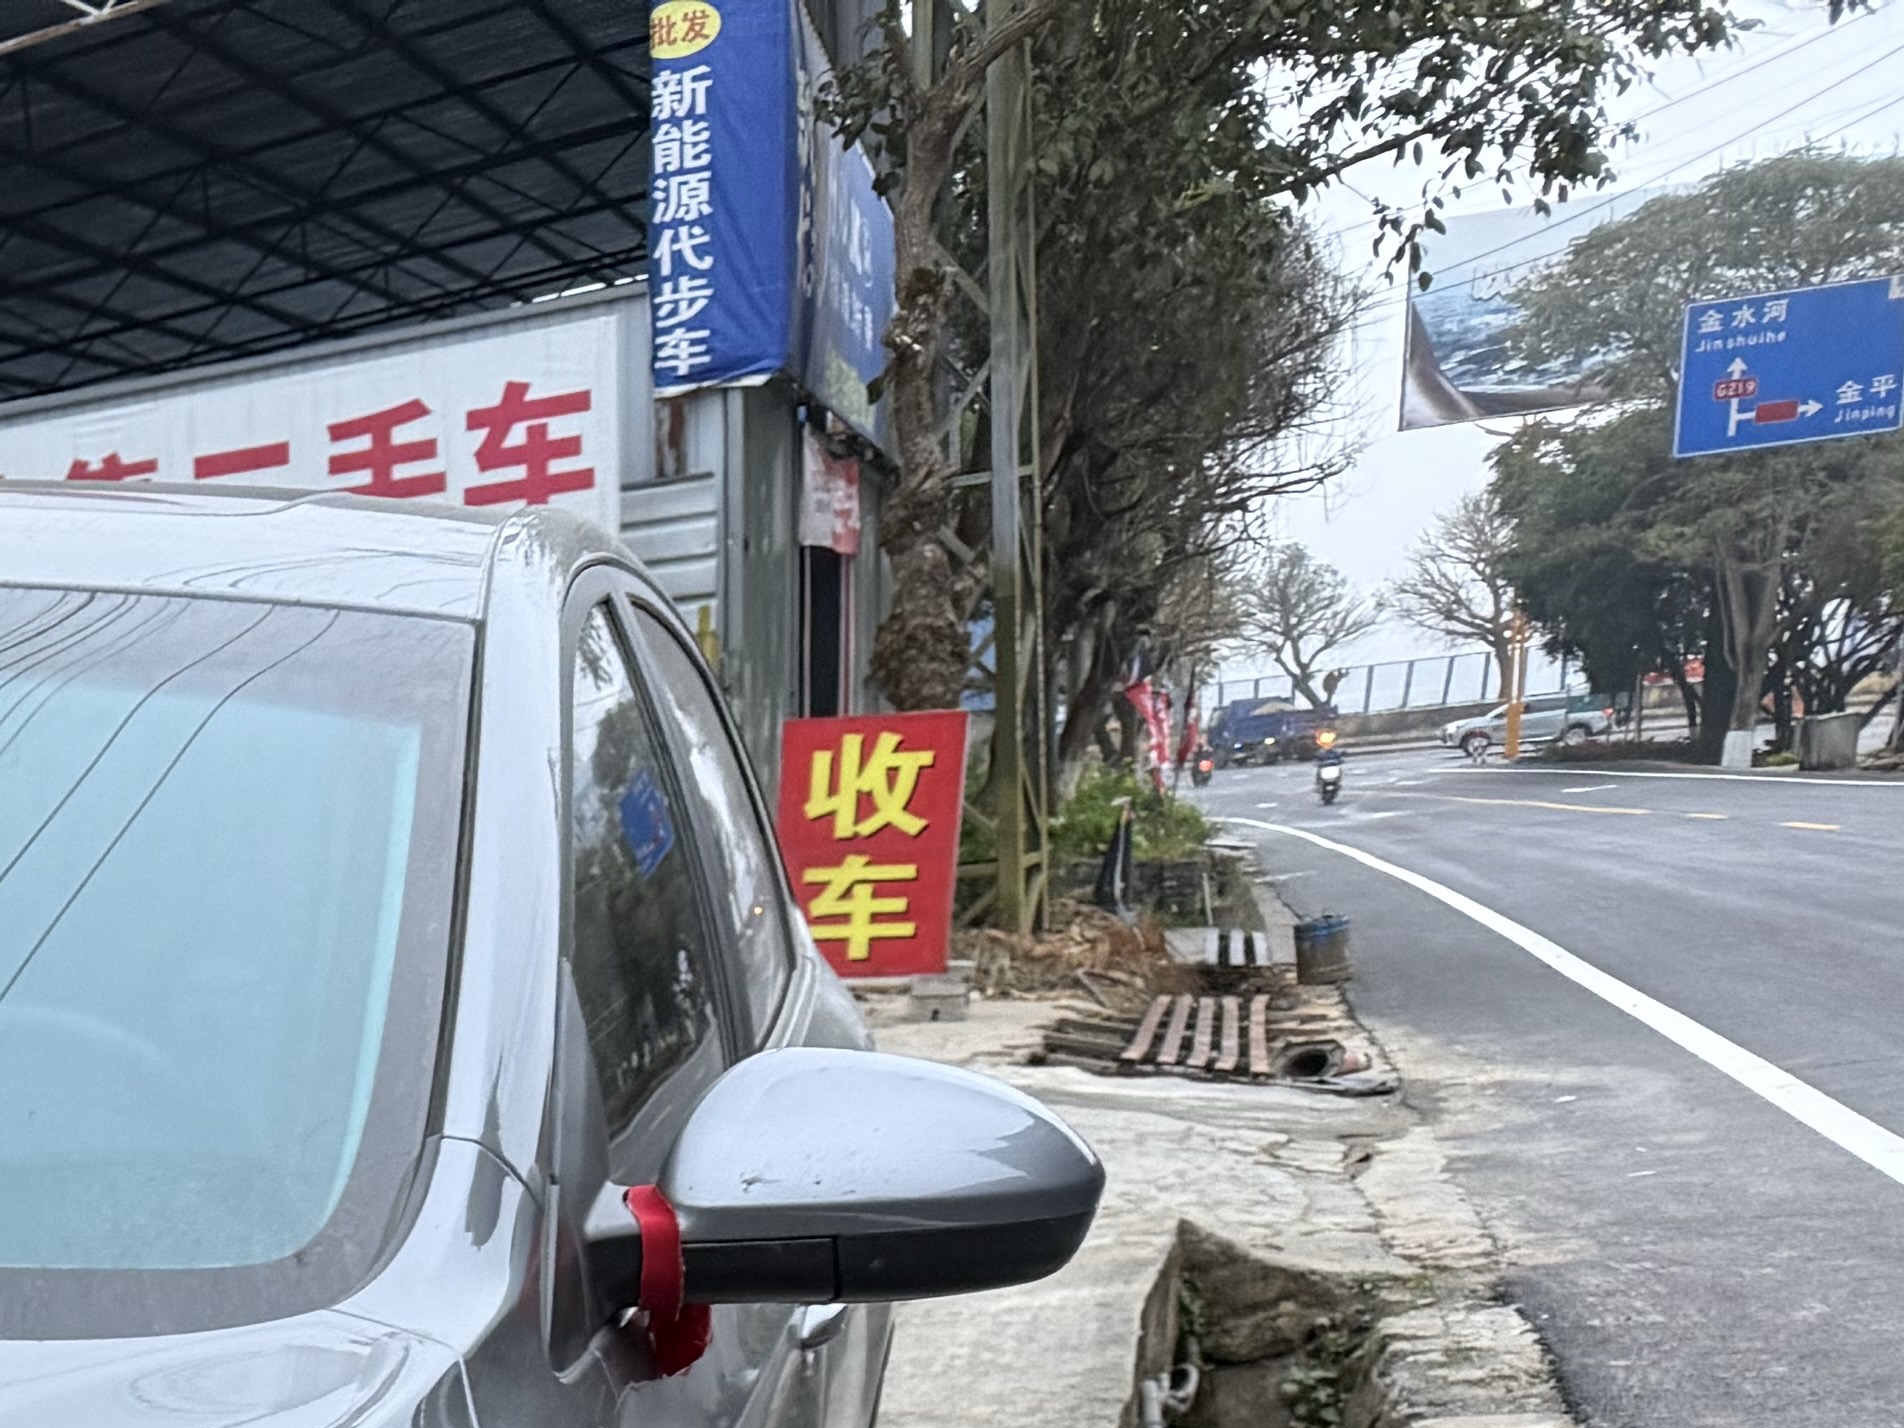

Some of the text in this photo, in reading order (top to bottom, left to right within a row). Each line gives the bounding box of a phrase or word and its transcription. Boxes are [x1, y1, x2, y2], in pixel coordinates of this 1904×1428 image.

[651, 10, 710, 49] 批发
[650, 64, 714, 377] 新能源代步车
[1697, 298, 1790, 334] 金水河
[1716, 380, 1757, 398] G219
[1835, 374, 1899, 405] 金平
[803, 731, 935, 961] 收车
